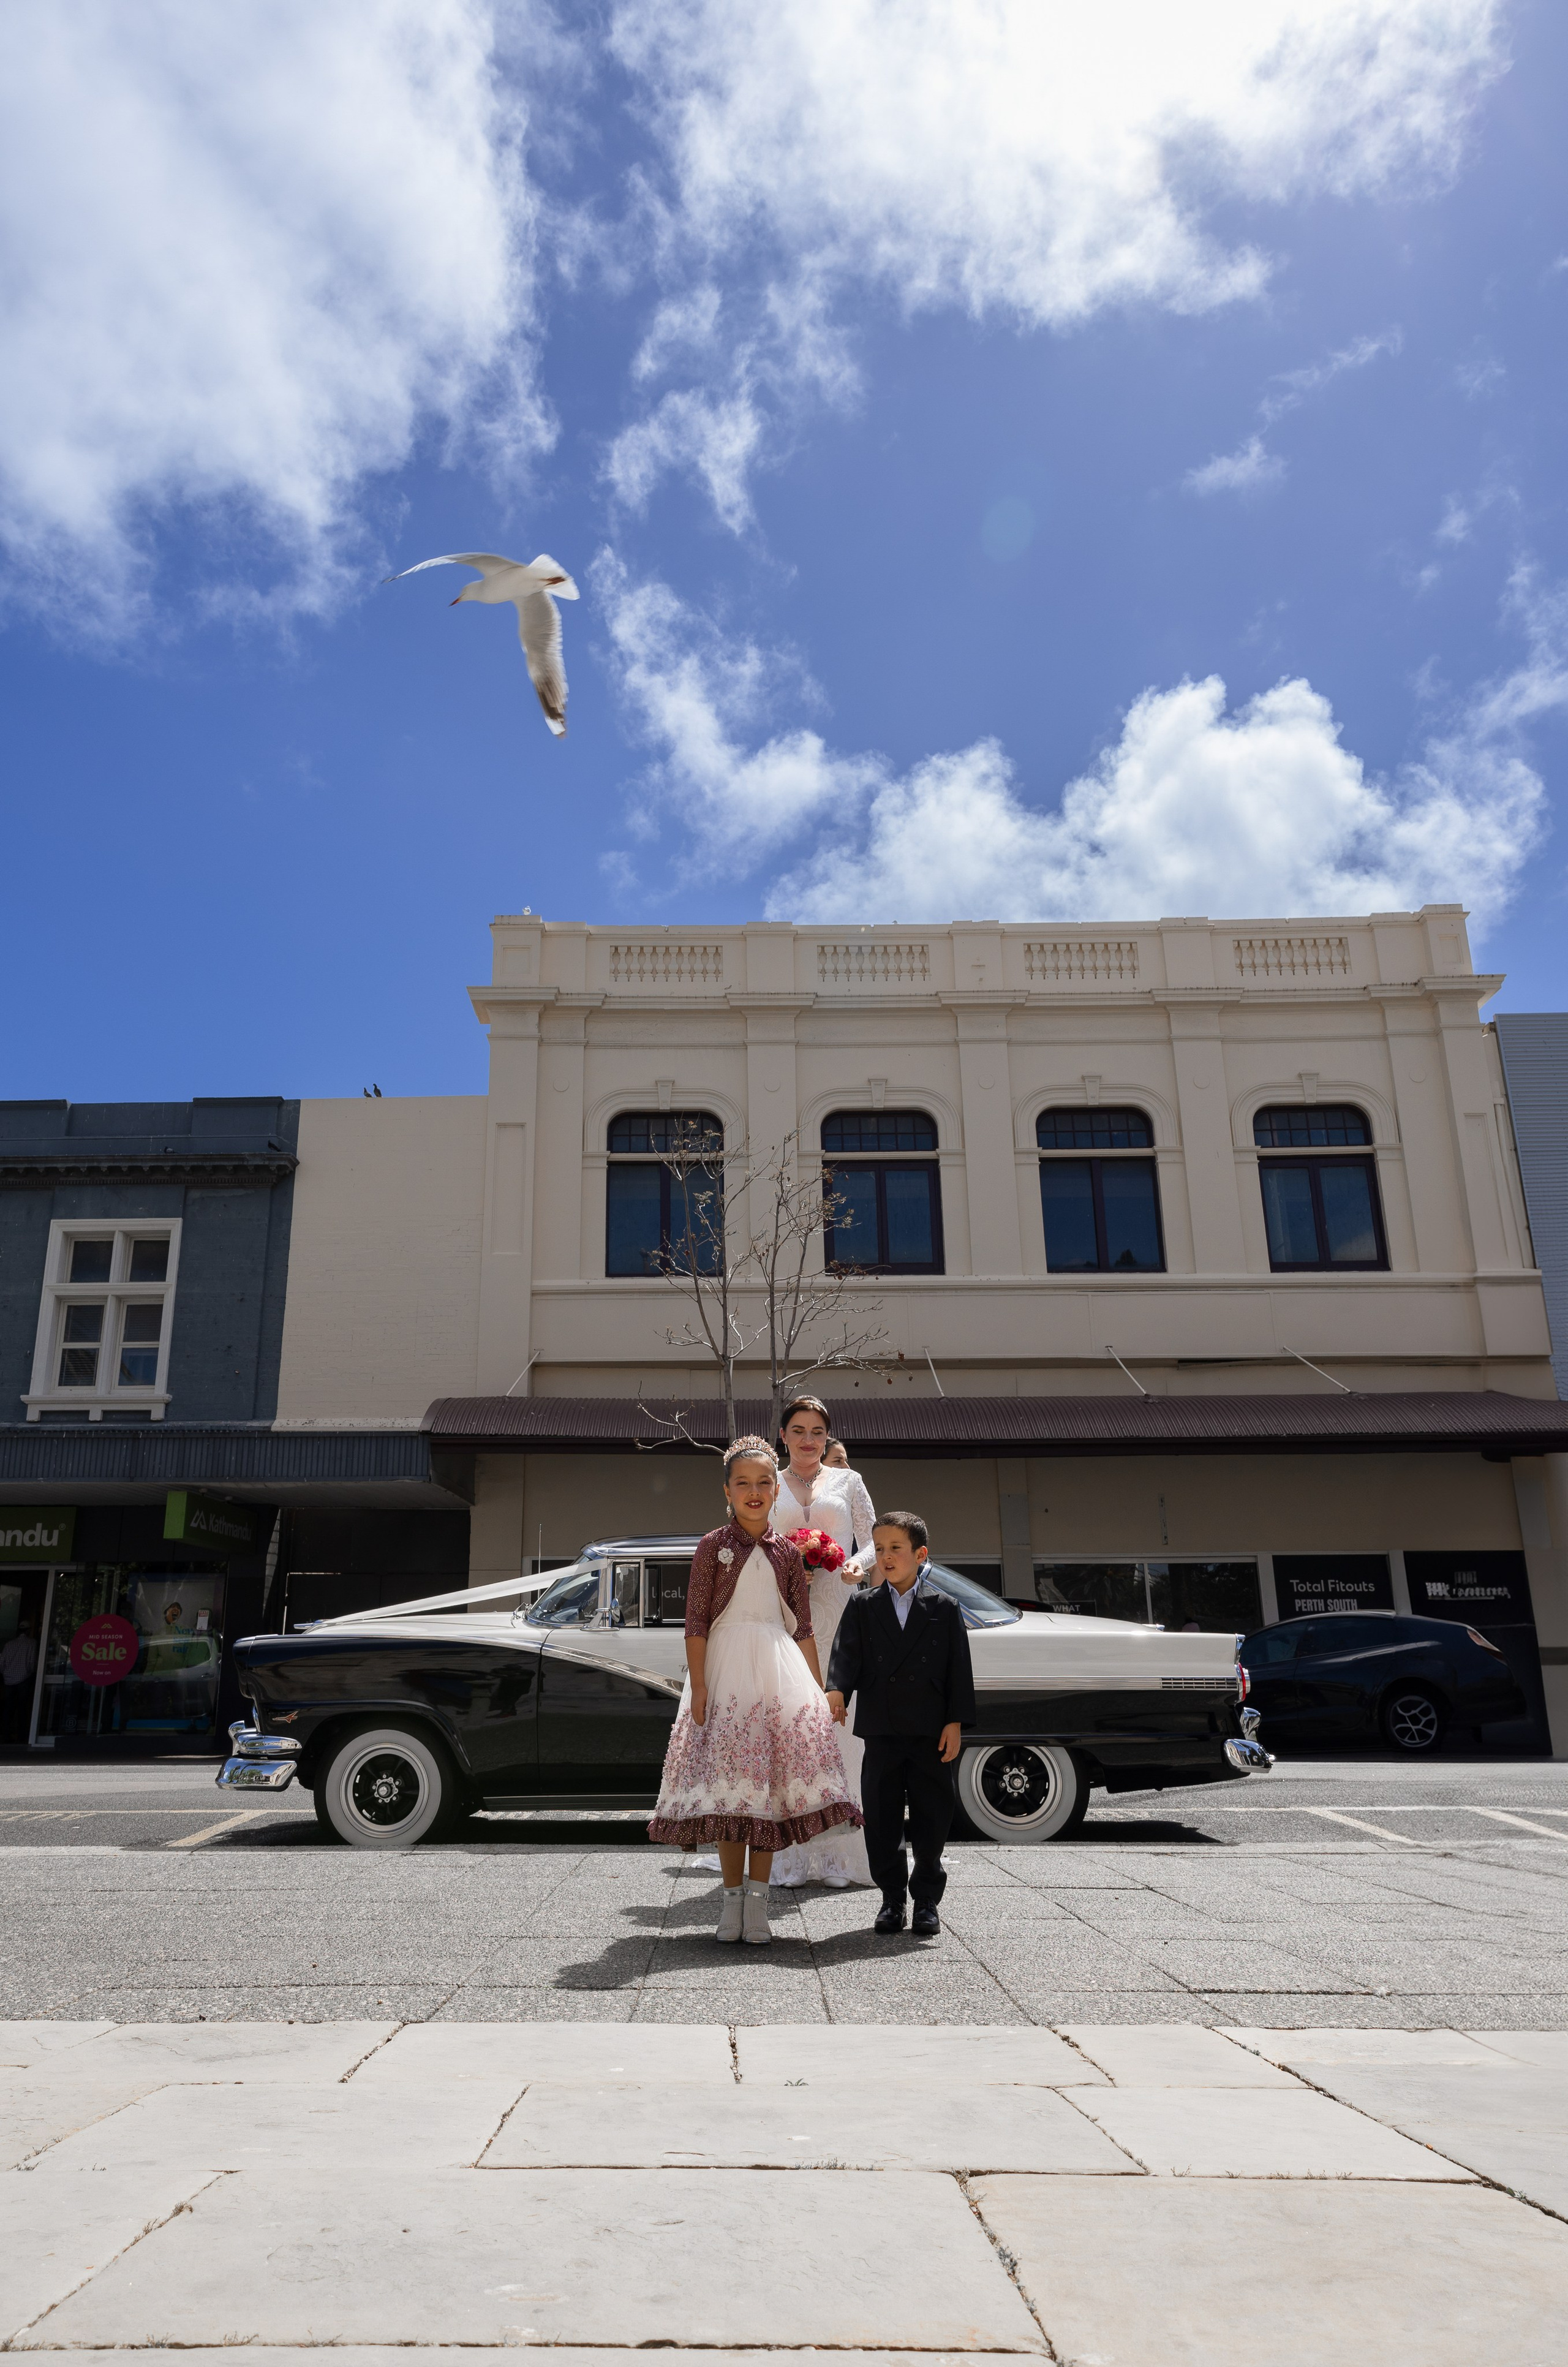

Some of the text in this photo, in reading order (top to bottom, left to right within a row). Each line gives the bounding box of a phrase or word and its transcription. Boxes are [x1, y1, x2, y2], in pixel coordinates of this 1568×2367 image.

[208, 1513, 252, 1541] Kathmandu
[1289, 1579, 1376, 1592] Total Fitouts
[1294, 1599, 1358, 1612] PERTH SOUTH
[81, 1642, 127, 1661] Sale
